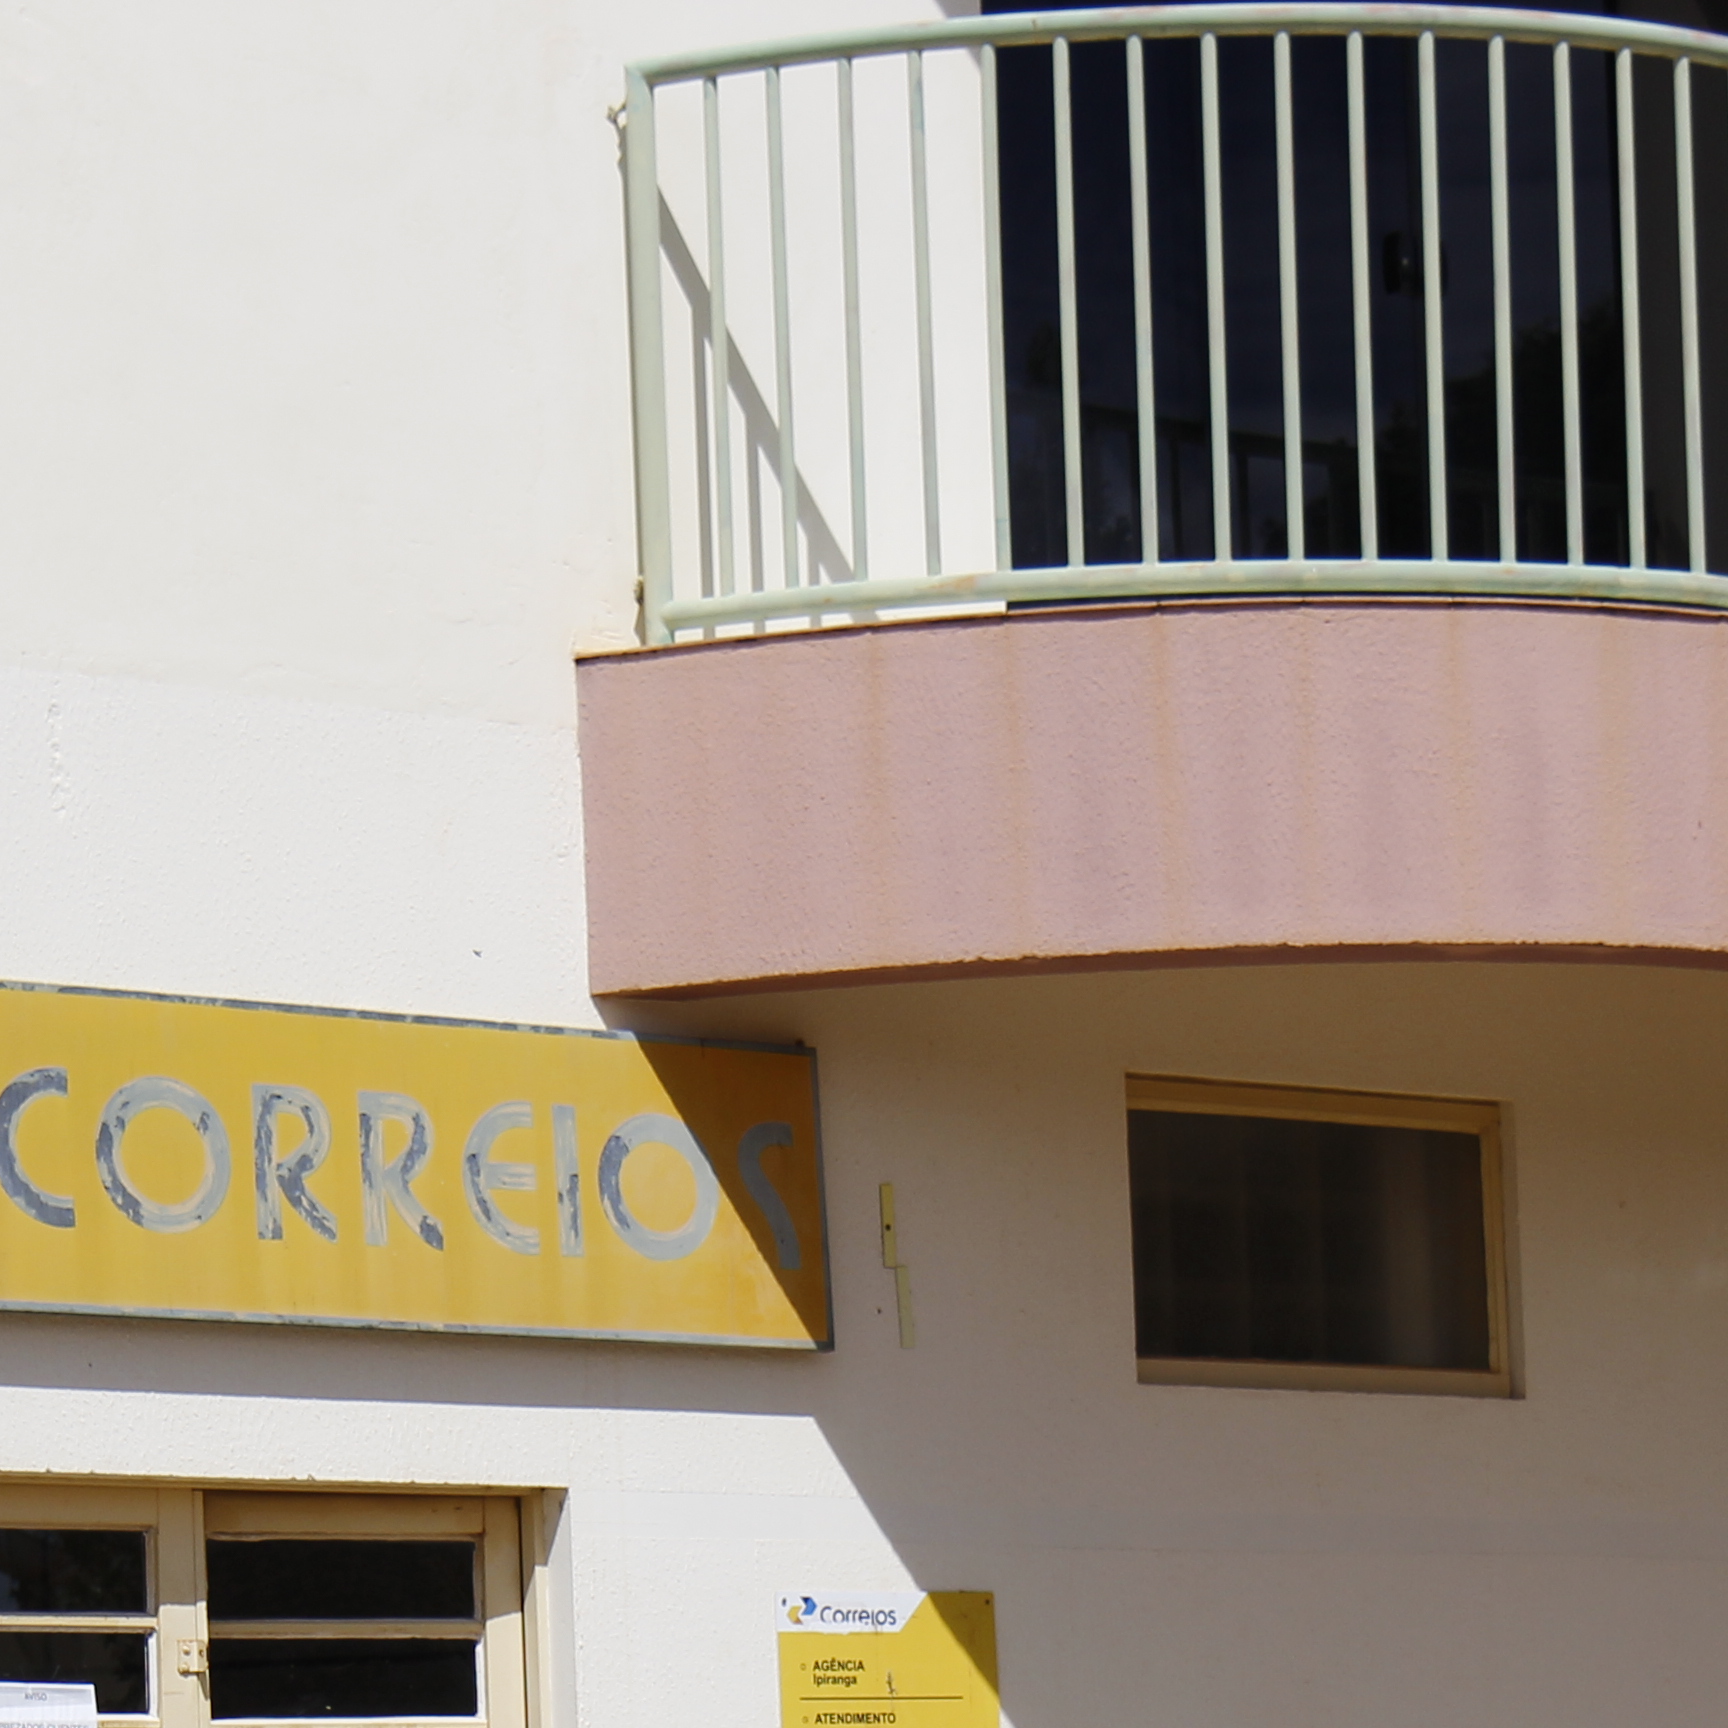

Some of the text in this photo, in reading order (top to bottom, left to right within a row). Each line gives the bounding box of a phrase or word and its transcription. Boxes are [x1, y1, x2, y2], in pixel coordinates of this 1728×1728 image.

[820, 1605, 897, 1627] Correios
[813, 1658, 865, 1671] AGÊNCIA
[813, 1672, 857, 1687] Ipiranga
[24, 1692, 47, 1701] AVISO
[814, 1712, 897, 1724] ATENDIMENTO
